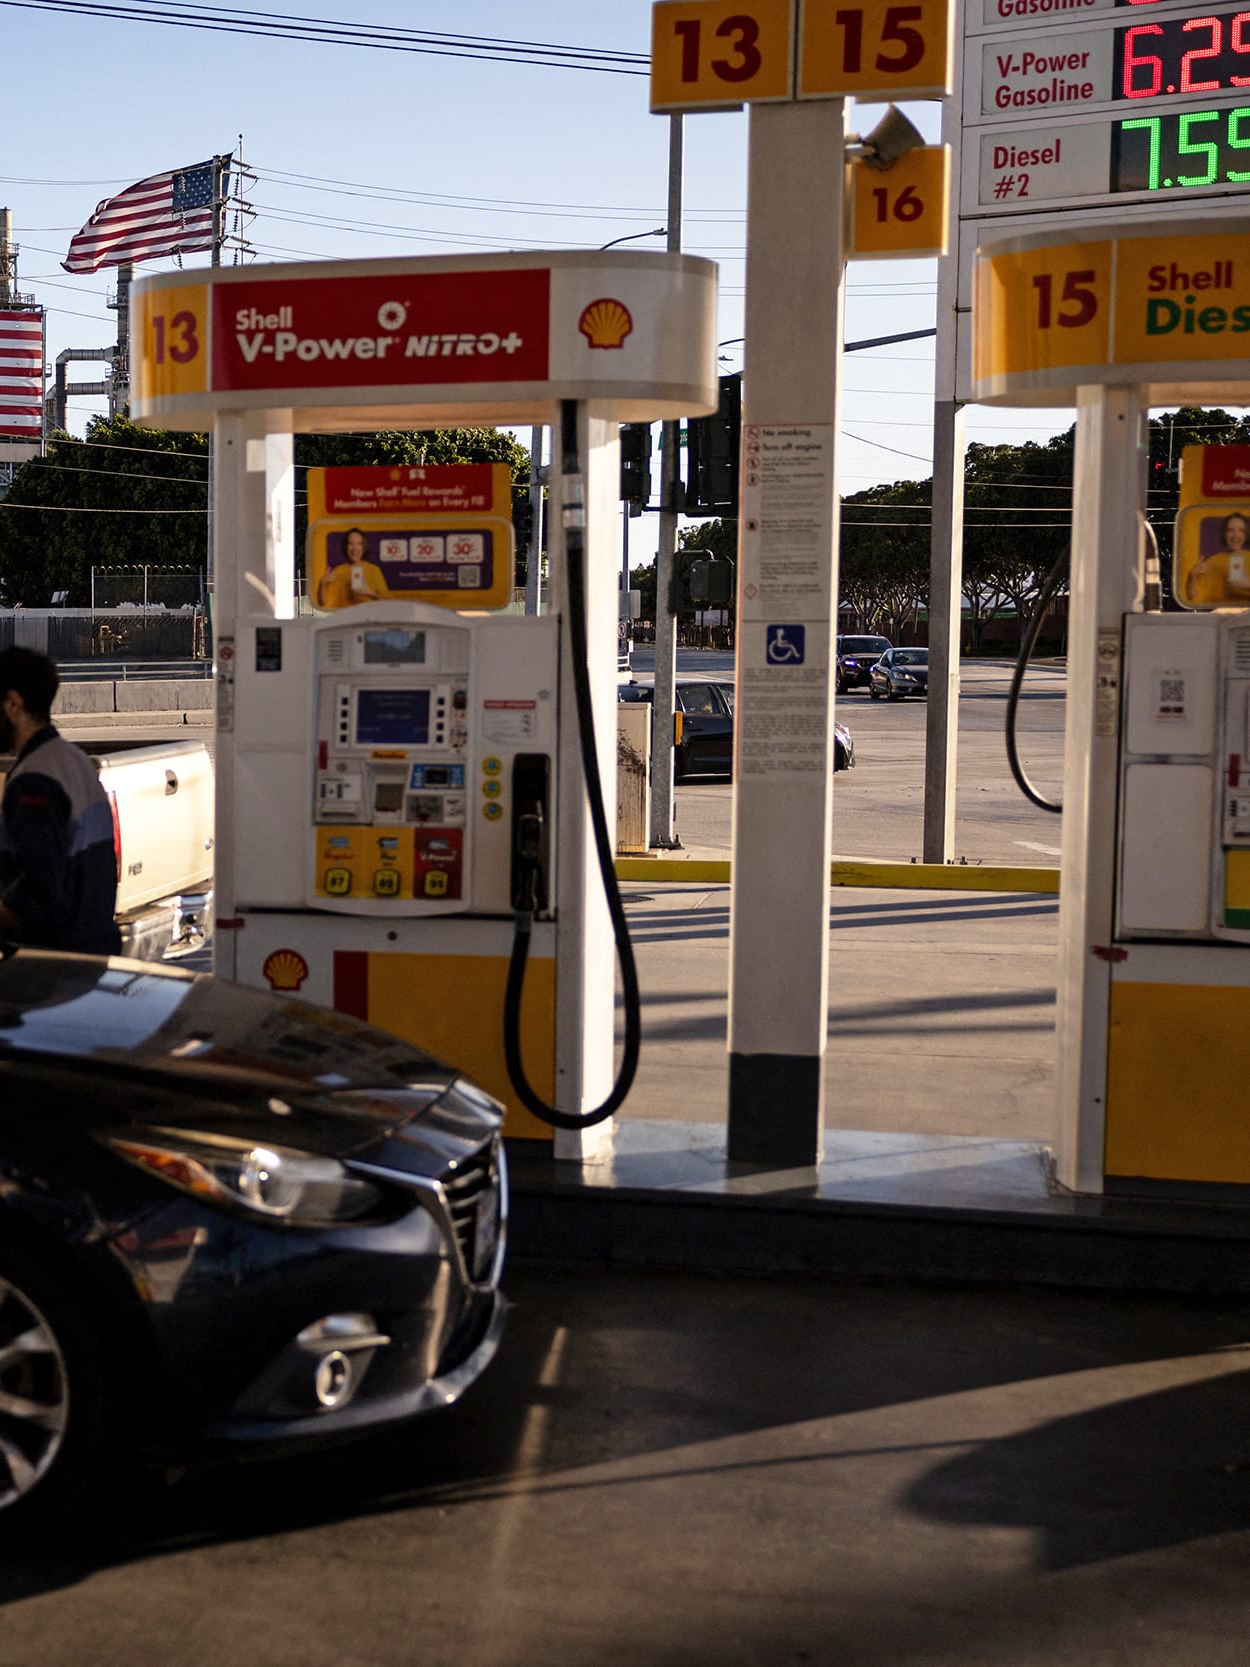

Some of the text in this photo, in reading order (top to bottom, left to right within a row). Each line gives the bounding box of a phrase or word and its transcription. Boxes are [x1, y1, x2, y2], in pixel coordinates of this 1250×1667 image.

[674, 15, 762, 83] 13
[836, 6, 925, 73] 15
[997, 52, 1090, 78] V-Power
[995, 79, 1094, 108] Gasoline
[993, 139, 1061, 169] Diesel
[993, 174, 1030, 199] #2
[872, 185, 924, 222] 16
[1148, 260, 1233, 292] Shell
[1033, 270, 1097, 329] 15
[1146, 294, 1250, 335] Dies
[235, 305, 293, 331] Shell
[152, 310, 199, 364] 13
[236, 331, 393, 363] V-Power
